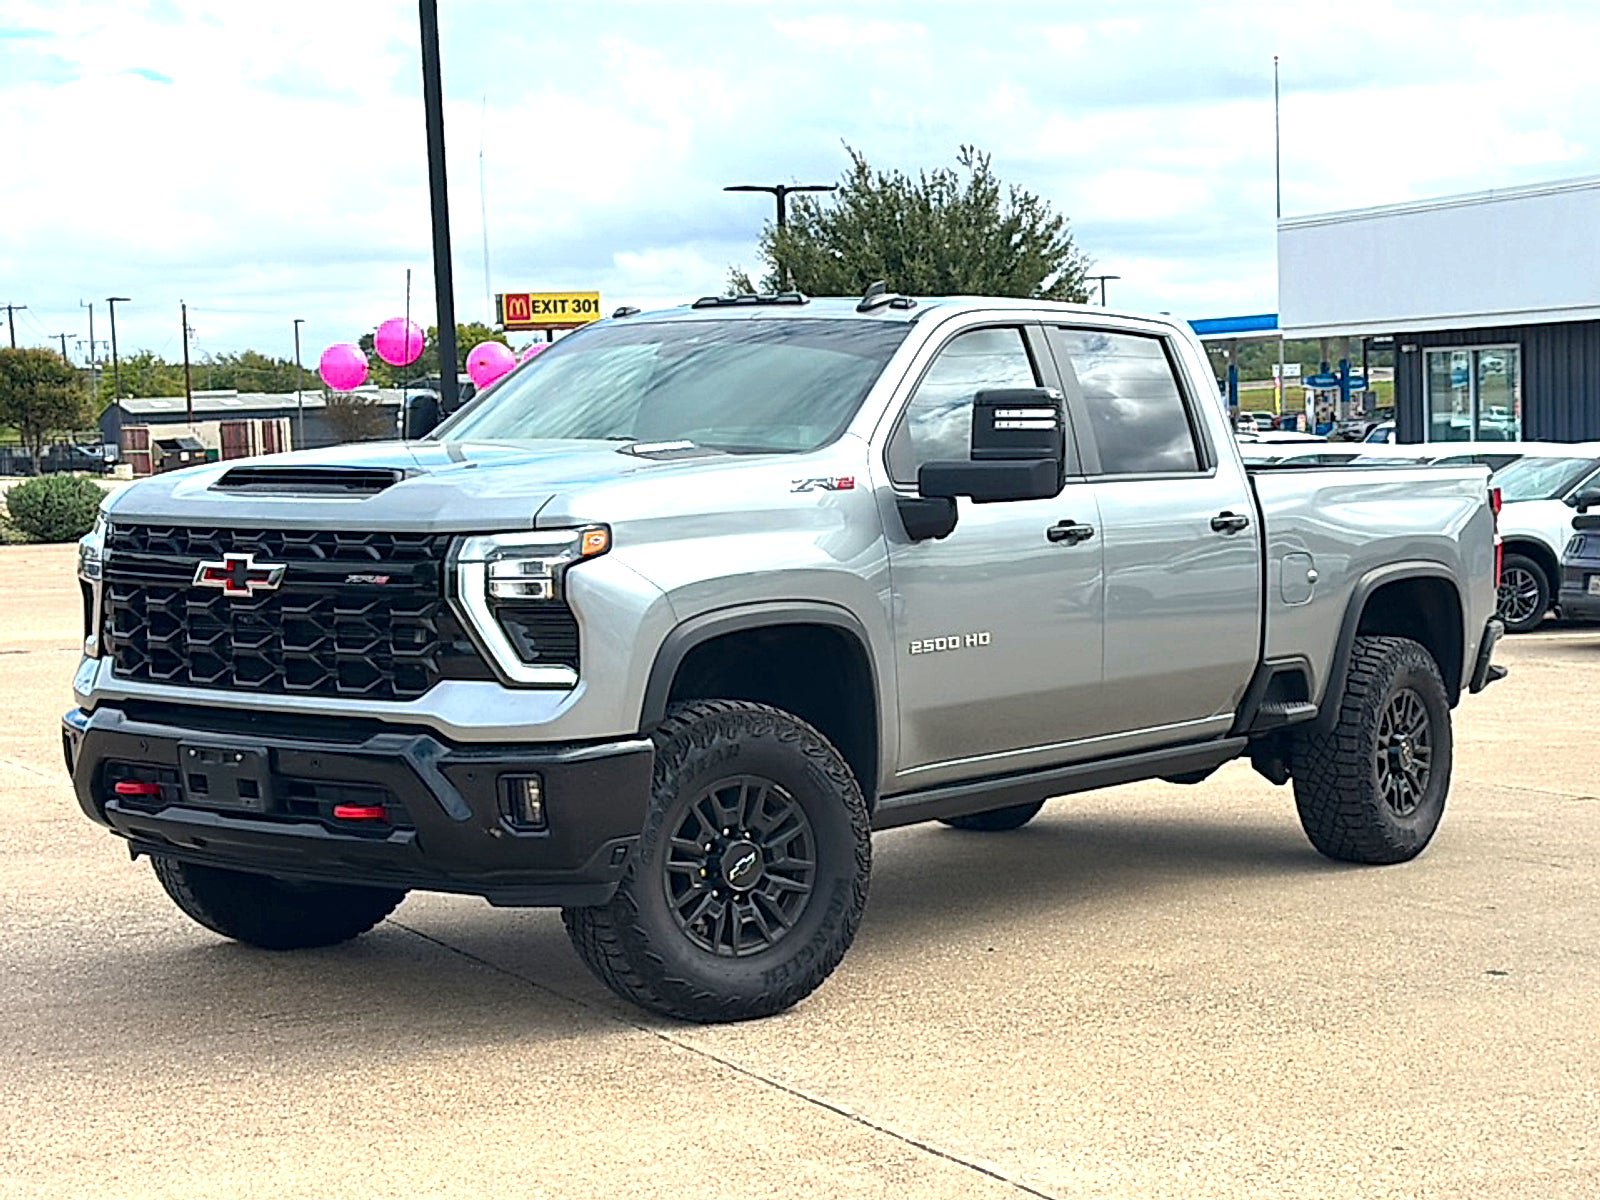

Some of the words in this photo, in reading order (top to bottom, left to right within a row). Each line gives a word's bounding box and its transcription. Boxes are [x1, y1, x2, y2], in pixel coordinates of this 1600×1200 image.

[531, 299, 569, 314] EXIT
[571, 298, 599, 313] 301
[910, 635, 961, 655] 2500
[964, 631, 991, 647] HD
